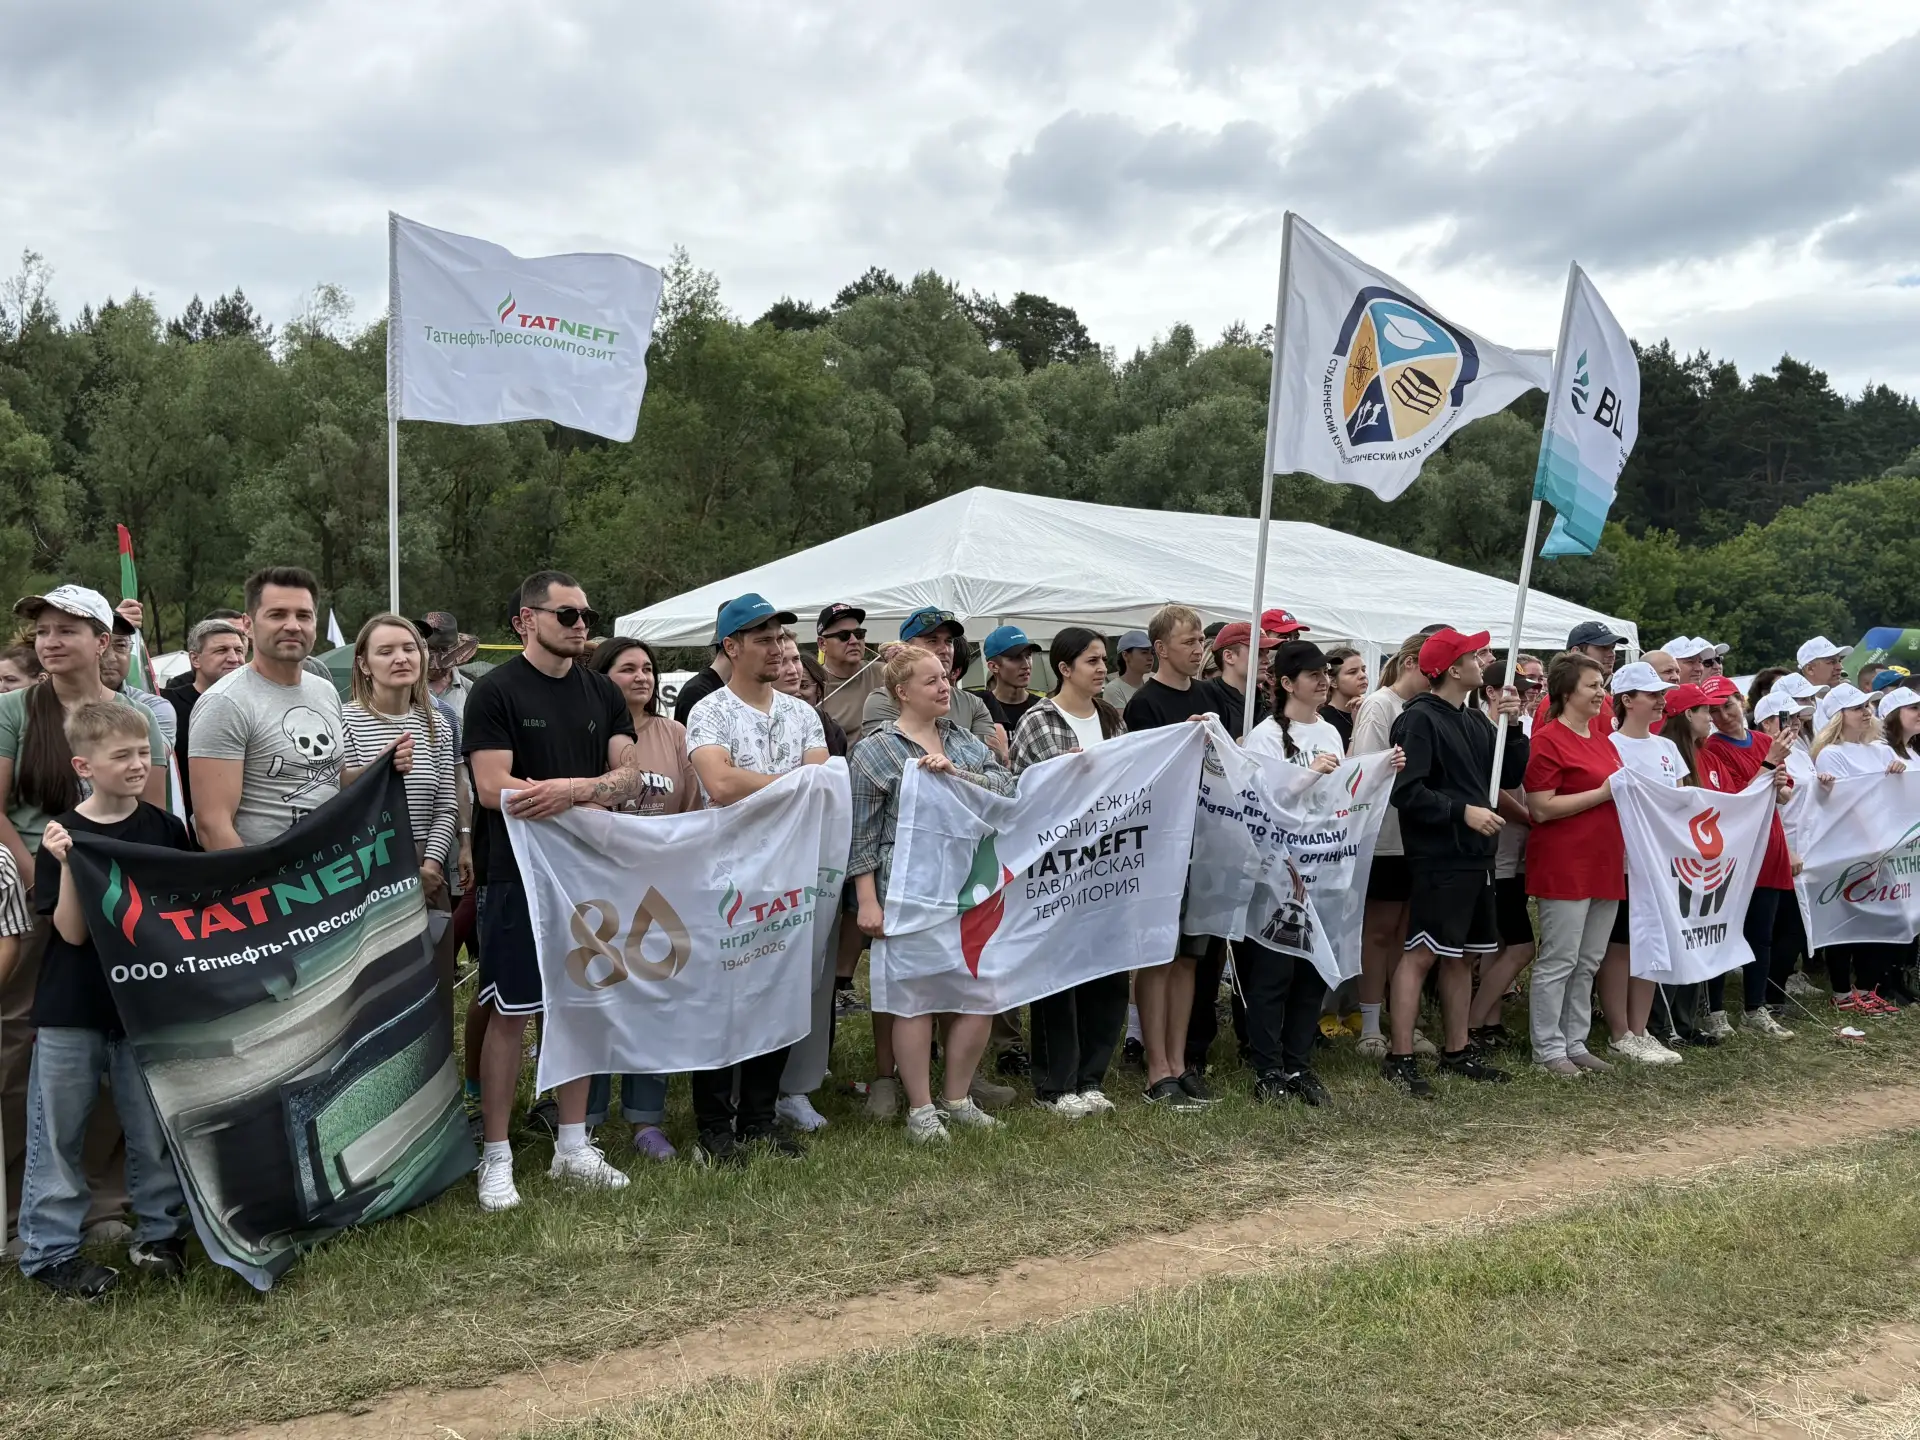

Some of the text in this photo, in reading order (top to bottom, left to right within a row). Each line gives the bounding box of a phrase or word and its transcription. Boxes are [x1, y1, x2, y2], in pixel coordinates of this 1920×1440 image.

[425, 326, 616, 361] Татнефть-Пресскомпозит
[518, 313, 620, 345] TATNEFT
[1323, 358, 1338, 434] СТУДЕНЧЕСКИЙ
[1398, 447, 1421, 461] КЛУБ
[159, 828, 396, 941] TATNEFT
[1033, 877, 1140, 921] ТЕРРИТОРИЯ
[719, 929, 760, 950] НГДУ
[721, 939, 787, 972] 1946-2026
[110, 961, 169, 984] ООО
